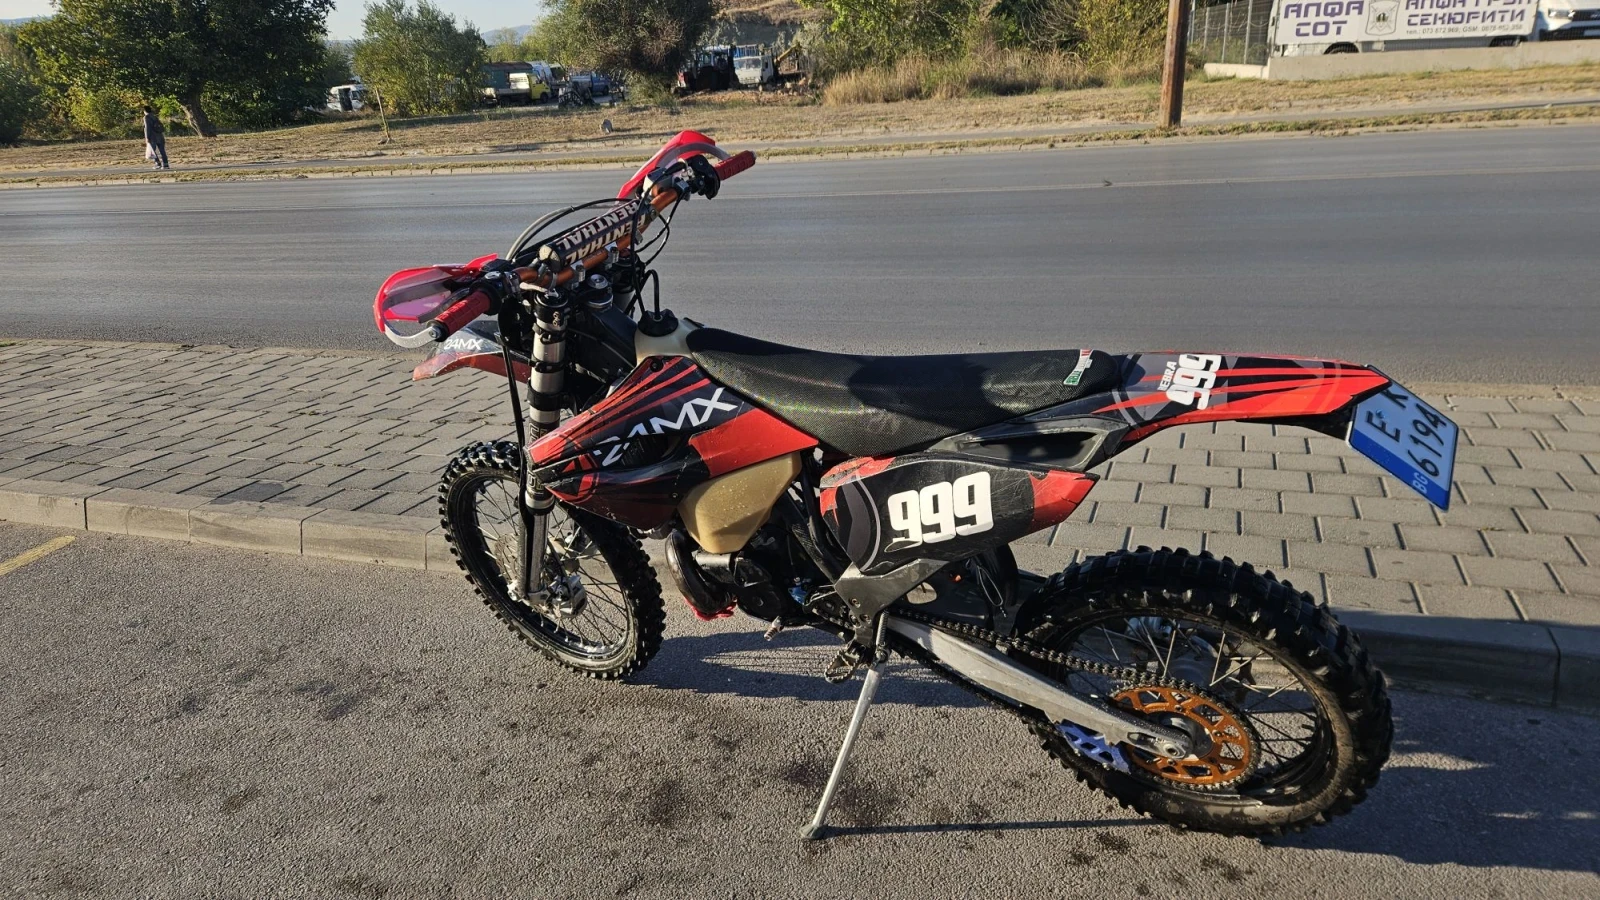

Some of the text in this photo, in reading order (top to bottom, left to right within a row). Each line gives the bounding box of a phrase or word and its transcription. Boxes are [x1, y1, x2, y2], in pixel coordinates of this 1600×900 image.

[1295, 20, 1348, 37] СОТ
[1407, 9, 1525, 26] СЕКЮРИТИ
[556, 201, 640, 250] RENTHAL
[564, 213, 647, 266] RENTHAL
[443, 338, 484, 351] 24MX
[1165, 353, 1222, 411] 999
[1365, 410, 1401, 443] E
[1407, 403, 1448, 477] 6194
[1412, 472, 1429, 494] BG
[887, 471, 994, 546] 999
